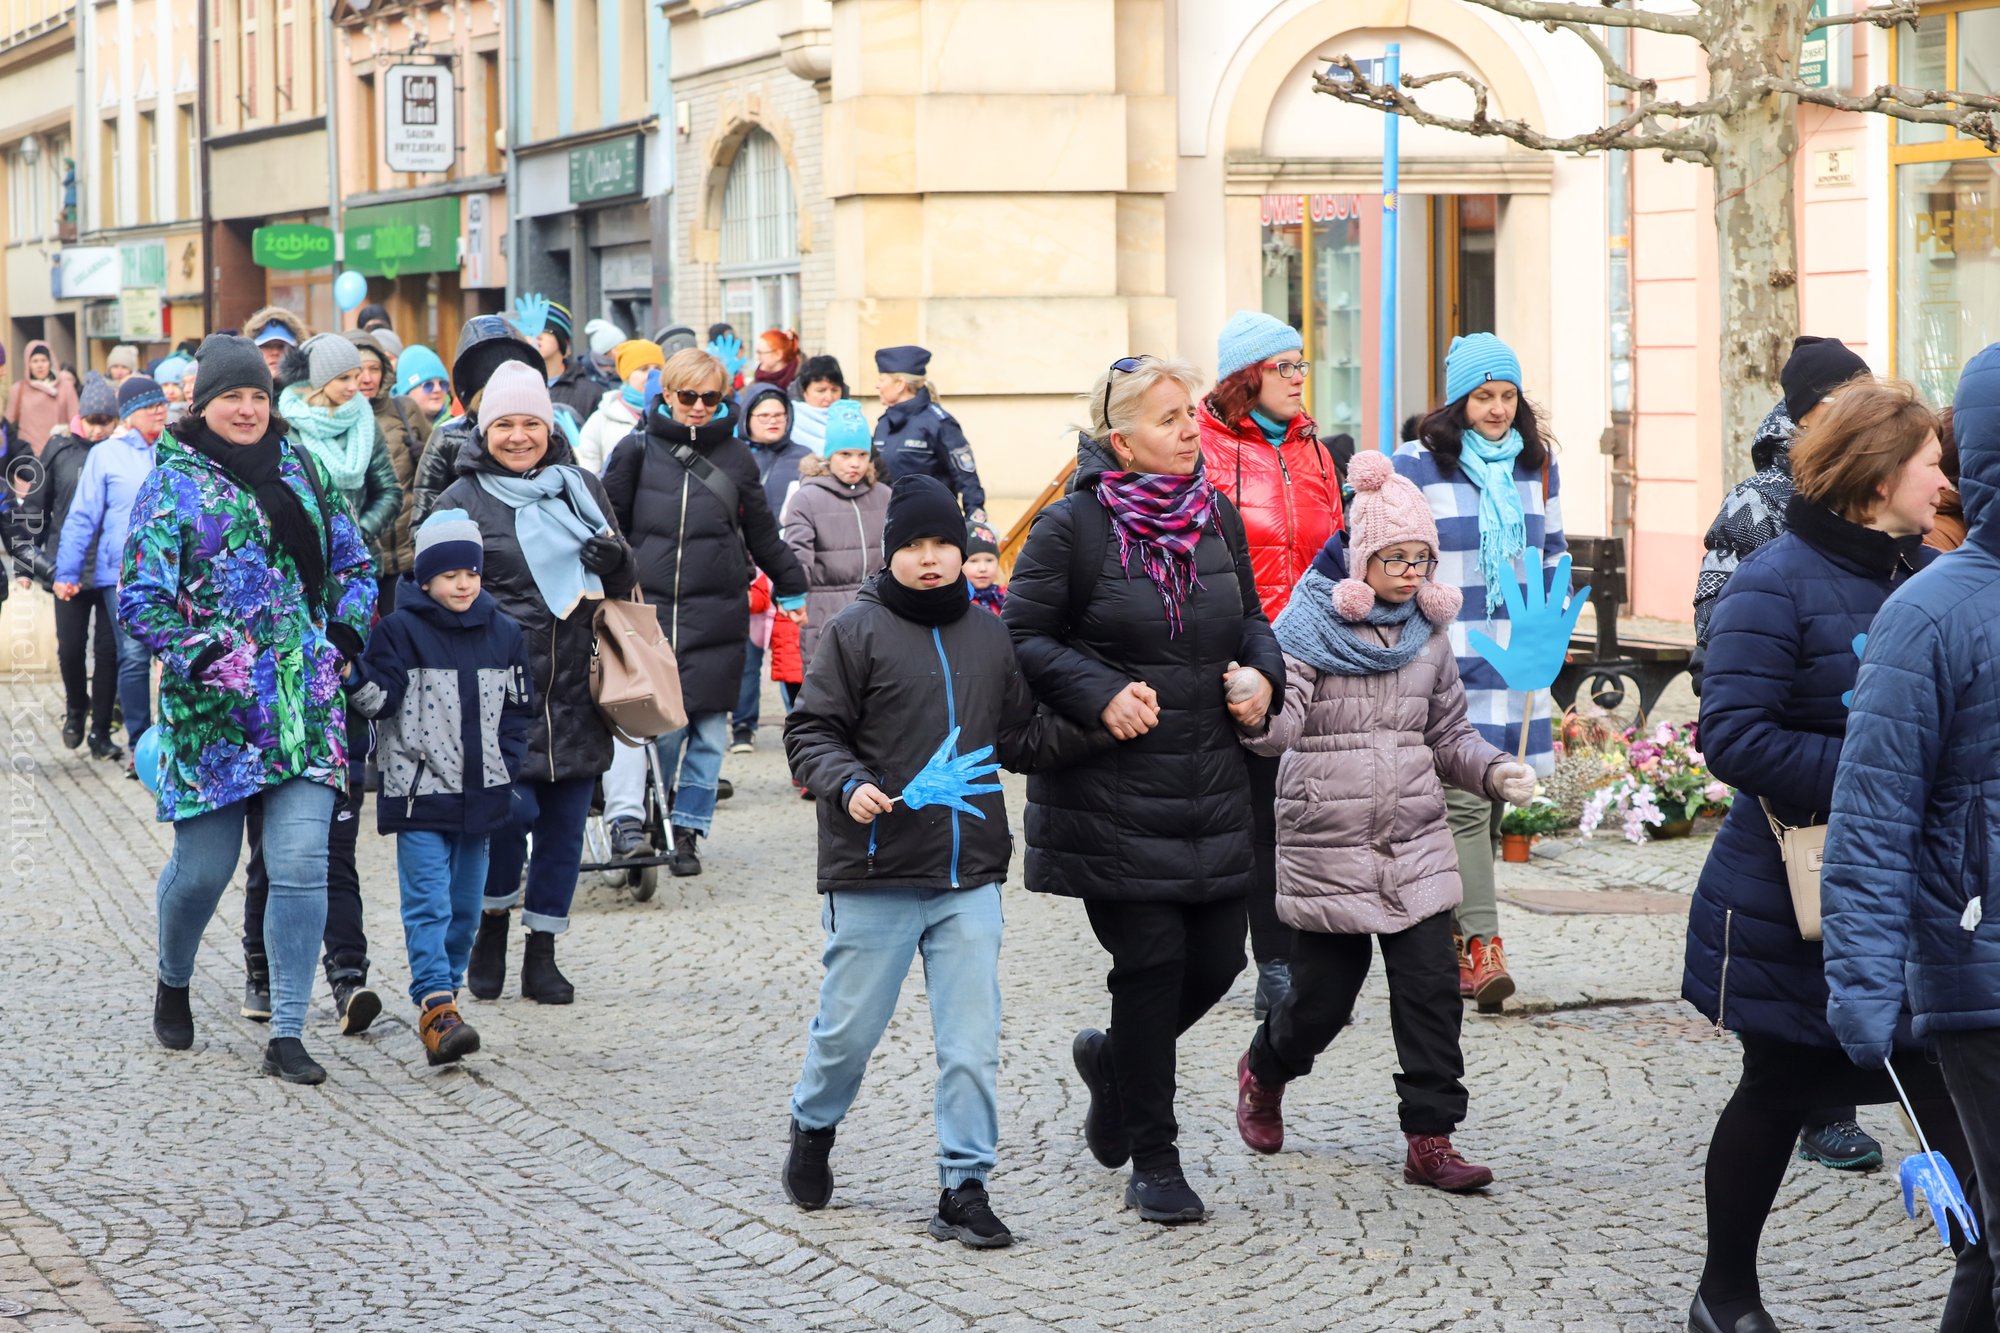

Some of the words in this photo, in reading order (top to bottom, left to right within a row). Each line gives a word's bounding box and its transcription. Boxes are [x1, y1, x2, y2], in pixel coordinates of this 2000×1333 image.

[405, 128, 435, 140] SALON
[394, 143, 447, 154] FRYZJERSKI
[264, 232, 330, 252] żabka
